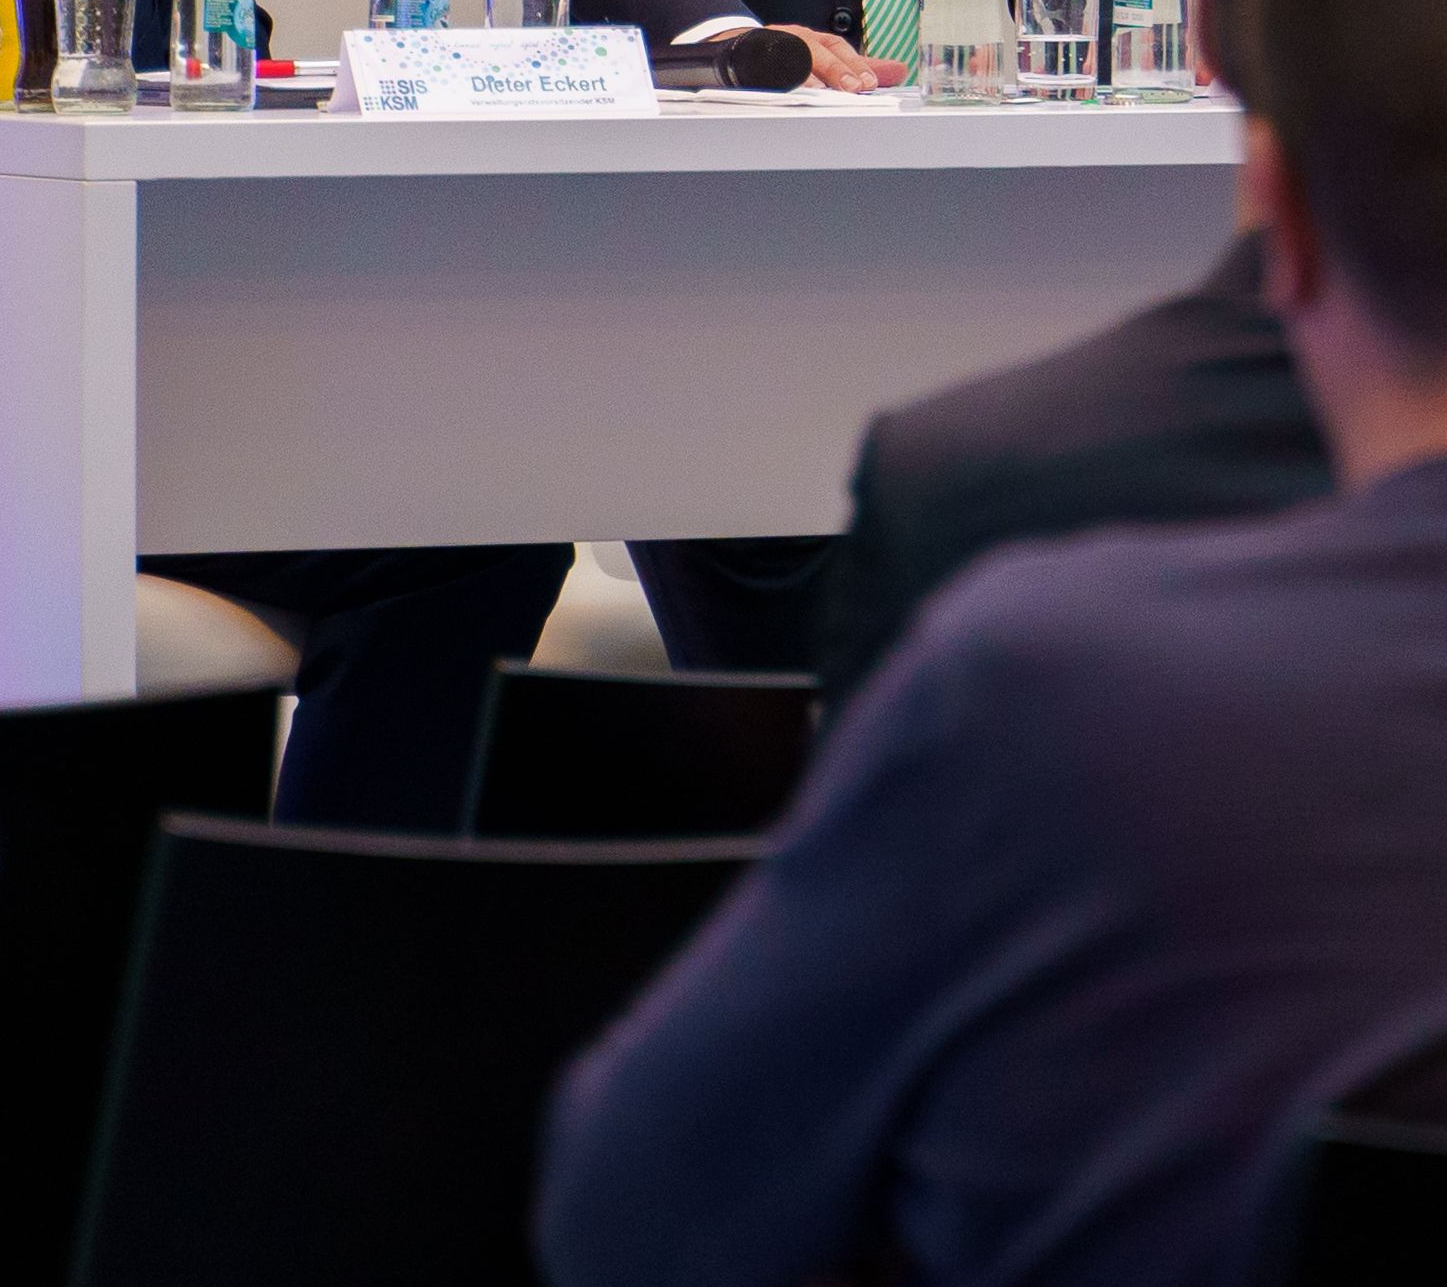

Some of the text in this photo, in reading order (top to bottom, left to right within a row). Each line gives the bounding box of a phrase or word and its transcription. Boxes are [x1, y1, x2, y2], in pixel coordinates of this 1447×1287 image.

[397, 80, 428, 94] SIS
[471, 75, 607, 92] Dieter Eckert
[380, 95, 419, 110] KSM
